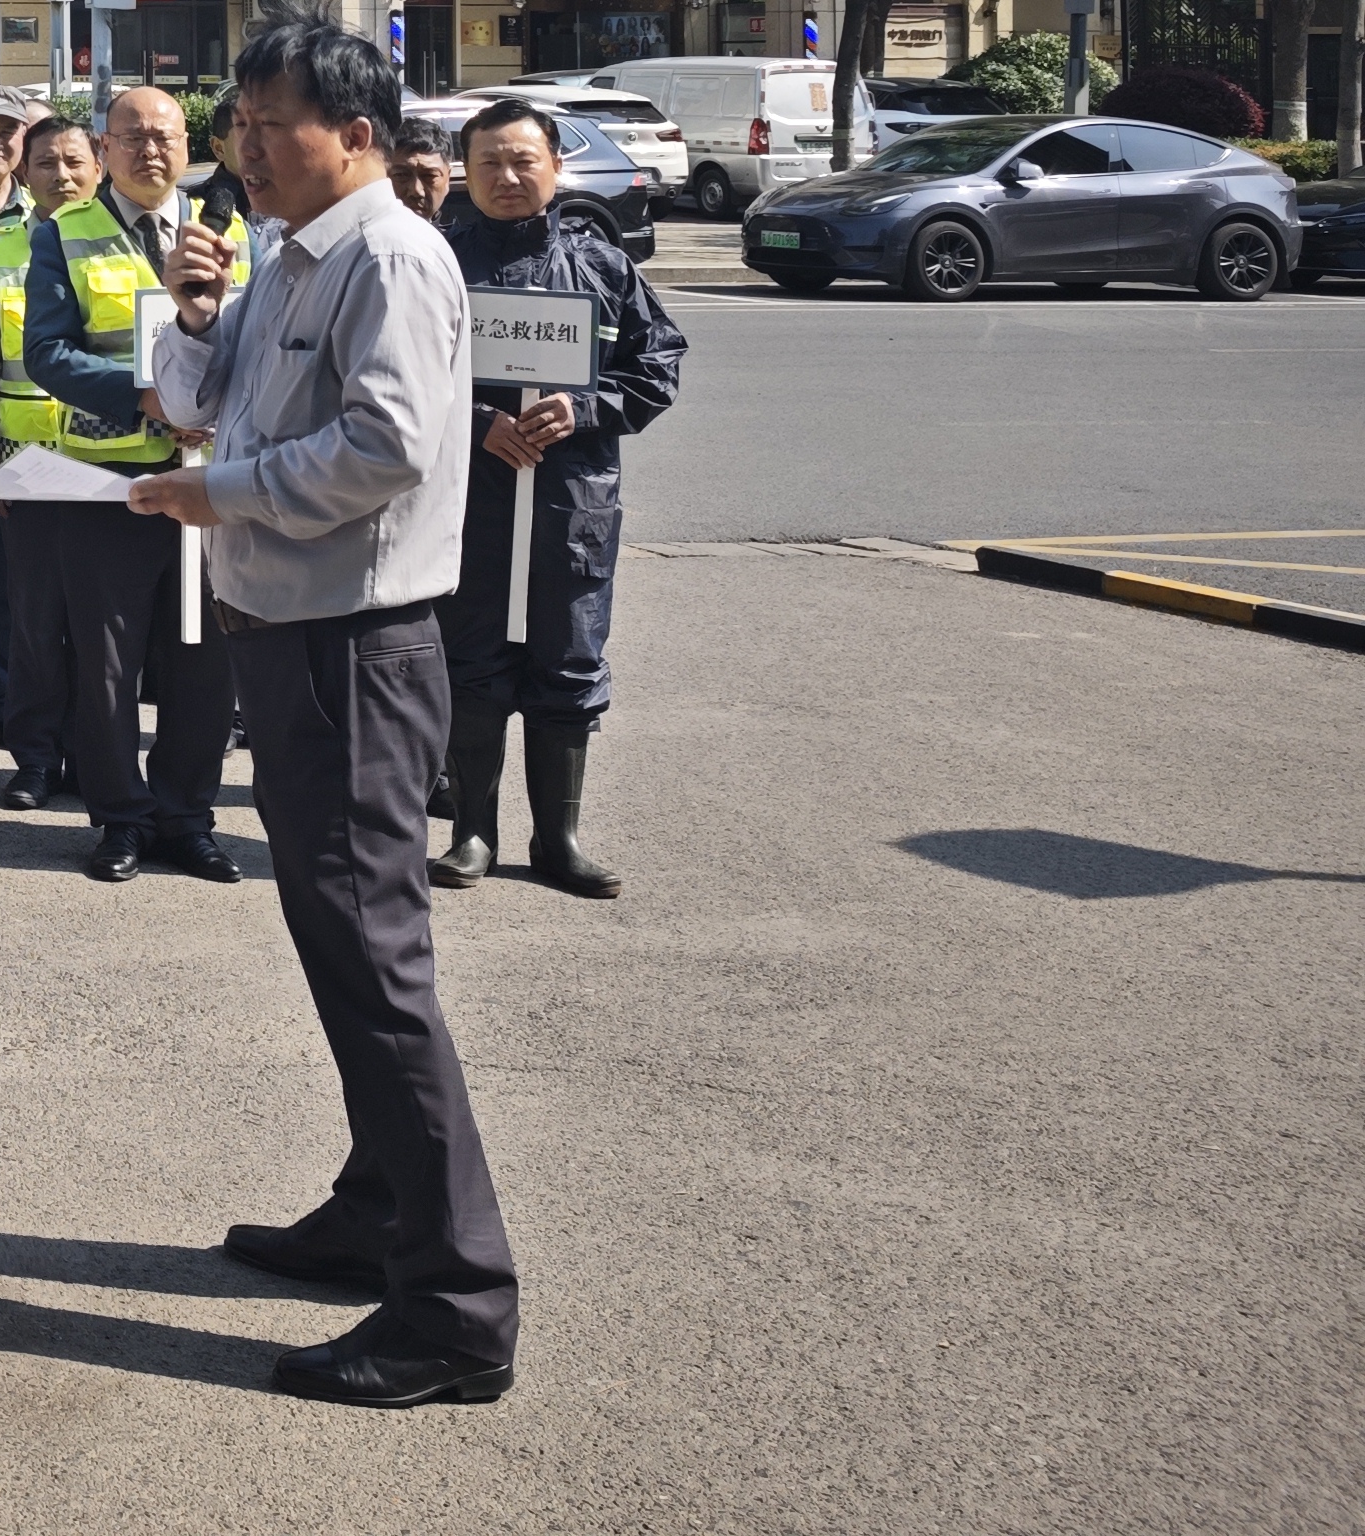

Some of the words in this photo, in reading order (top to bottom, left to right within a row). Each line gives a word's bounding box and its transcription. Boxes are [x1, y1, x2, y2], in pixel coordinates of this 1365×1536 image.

[470, 317, 580, 344] 应急救援组
